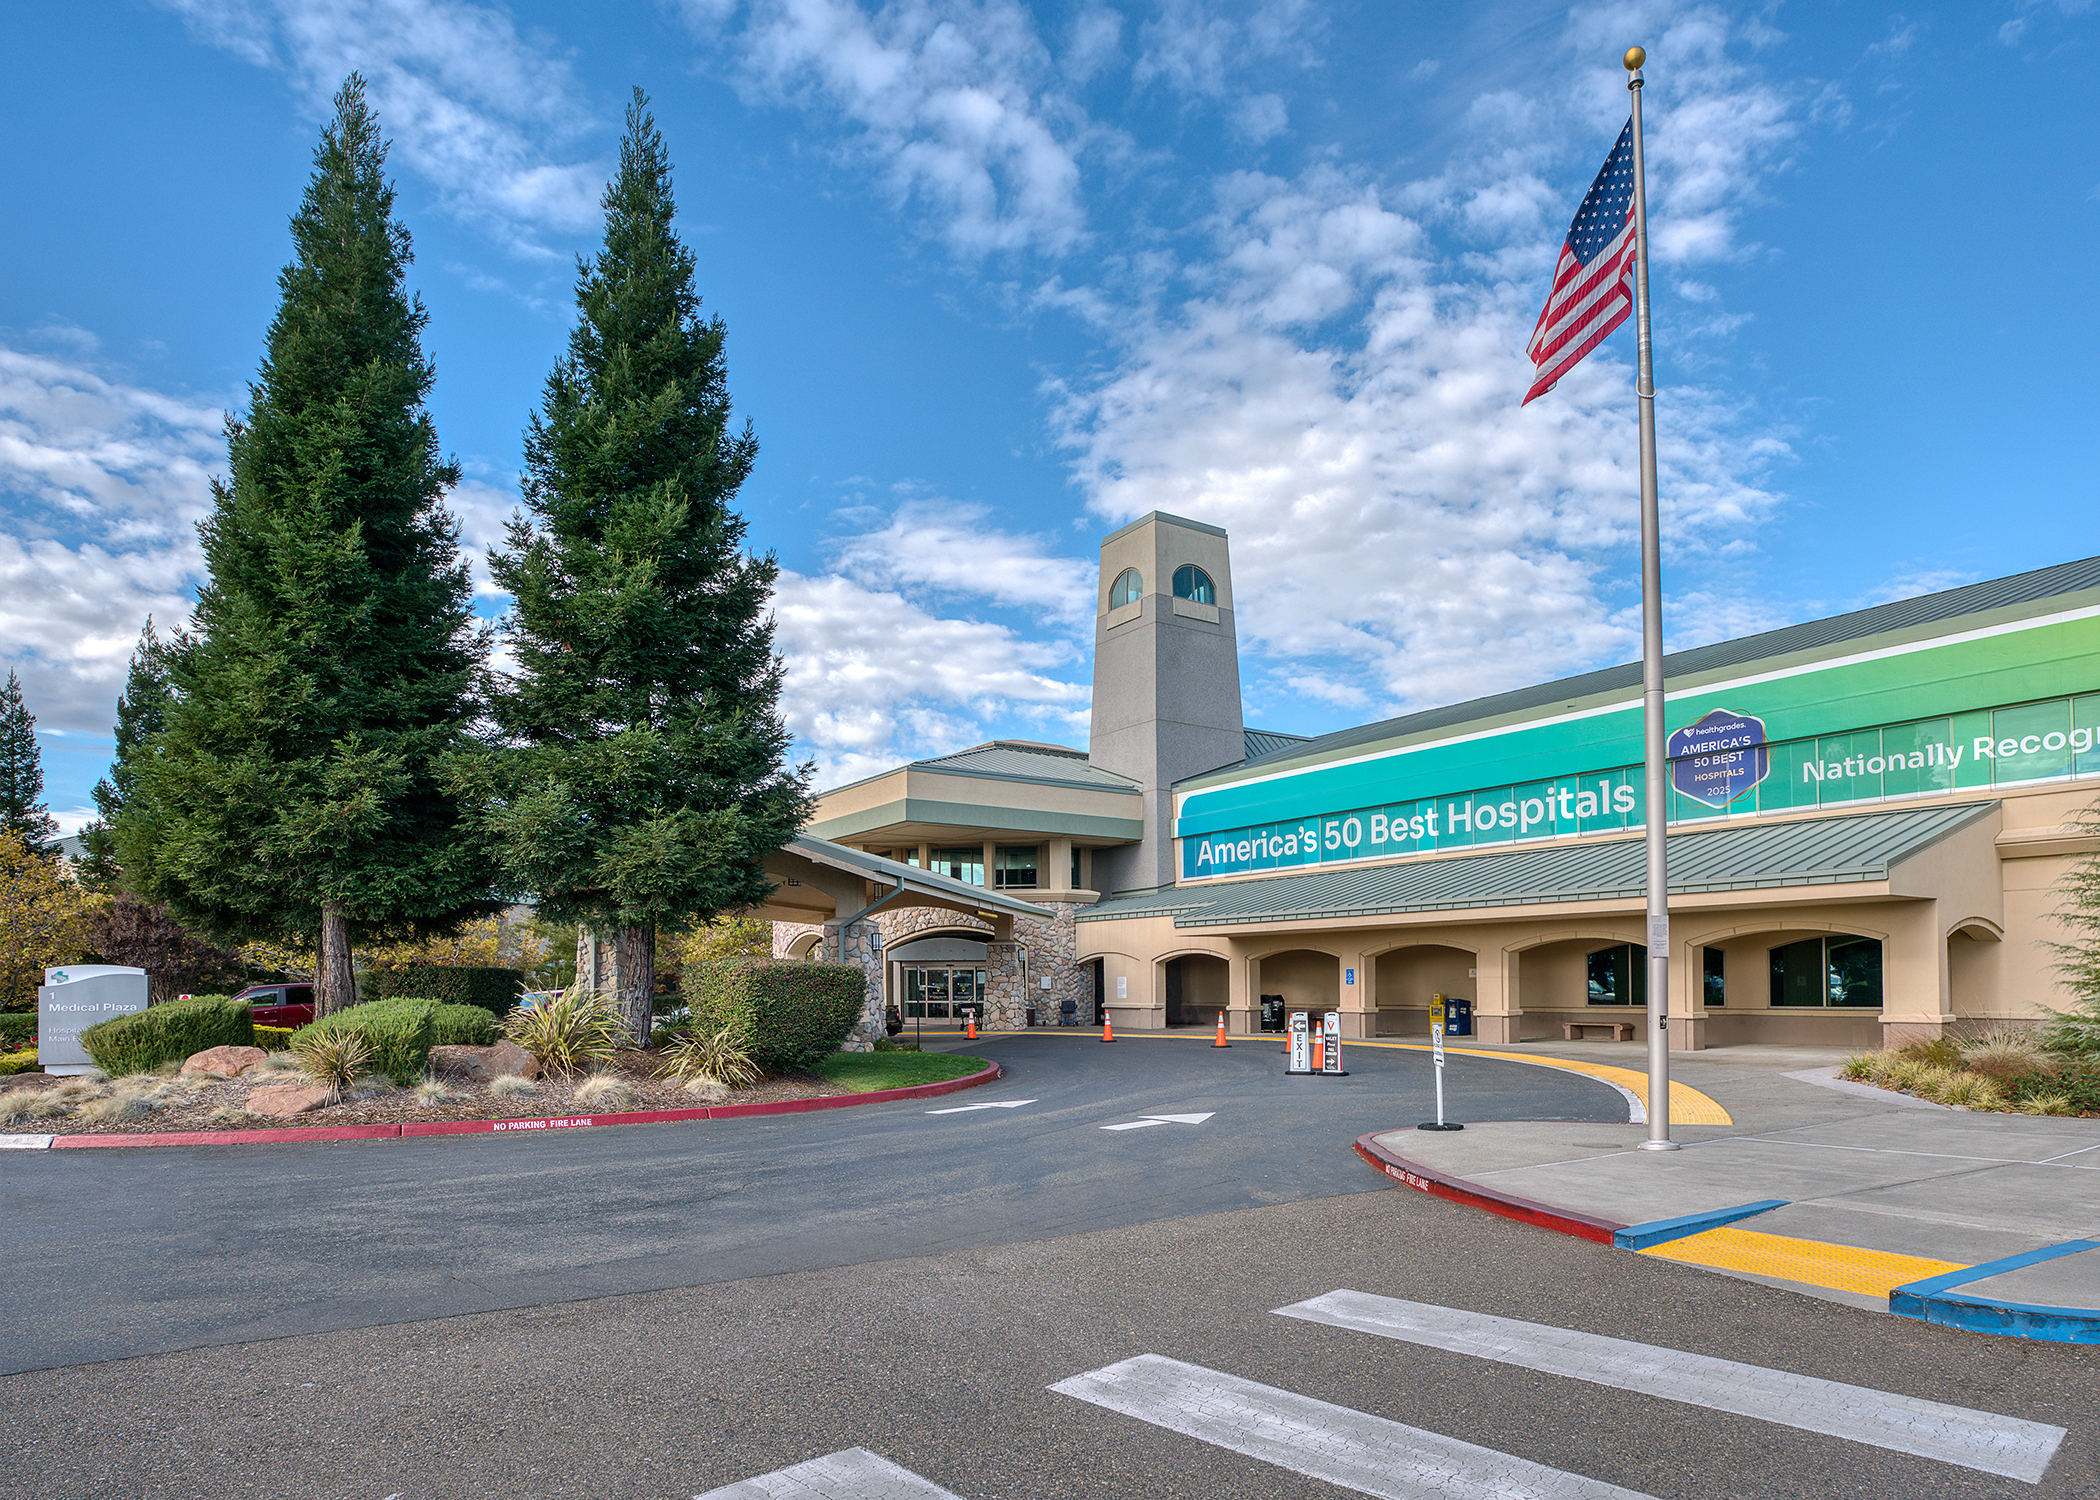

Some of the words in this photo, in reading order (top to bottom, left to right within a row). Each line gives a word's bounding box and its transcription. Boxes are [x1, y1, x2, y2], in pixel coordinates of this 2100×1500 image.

[1681, 735, 1752, 755] AMERICA'S
[1694, 756, 1710, 768] 50
[1712, 751, 1745, 766] BEST
[1803, 742, 1964, 783] Nationally
[1973, 726, 2100, 761] Recog
[1694, 767, 1745, 782] HOSPITALS
[1707, 785, 1731, 797] 2025
[1197, 825, 1318, 867] America's
[1324, 817, 1363, 850] 50
[1370, 807, 1439, 845] Best
[1448, 779, 1636, 835] Hospitals
[49, 991, 56, 1000] 1
[48, 1003, 100, 1012] Medical
[103, 1003, 138, 1012] Plaza
[493, 1122, 507, 1131] NO
[508, 1120, 546, 1131] PARKING
[550, 1119, 569, 1128] FIRE
[570, 1118, 593, 1127] LANE
[1406, 1173, 1416, 1186] FIRE
[1417, 1177, 1429, 1191] LANE
